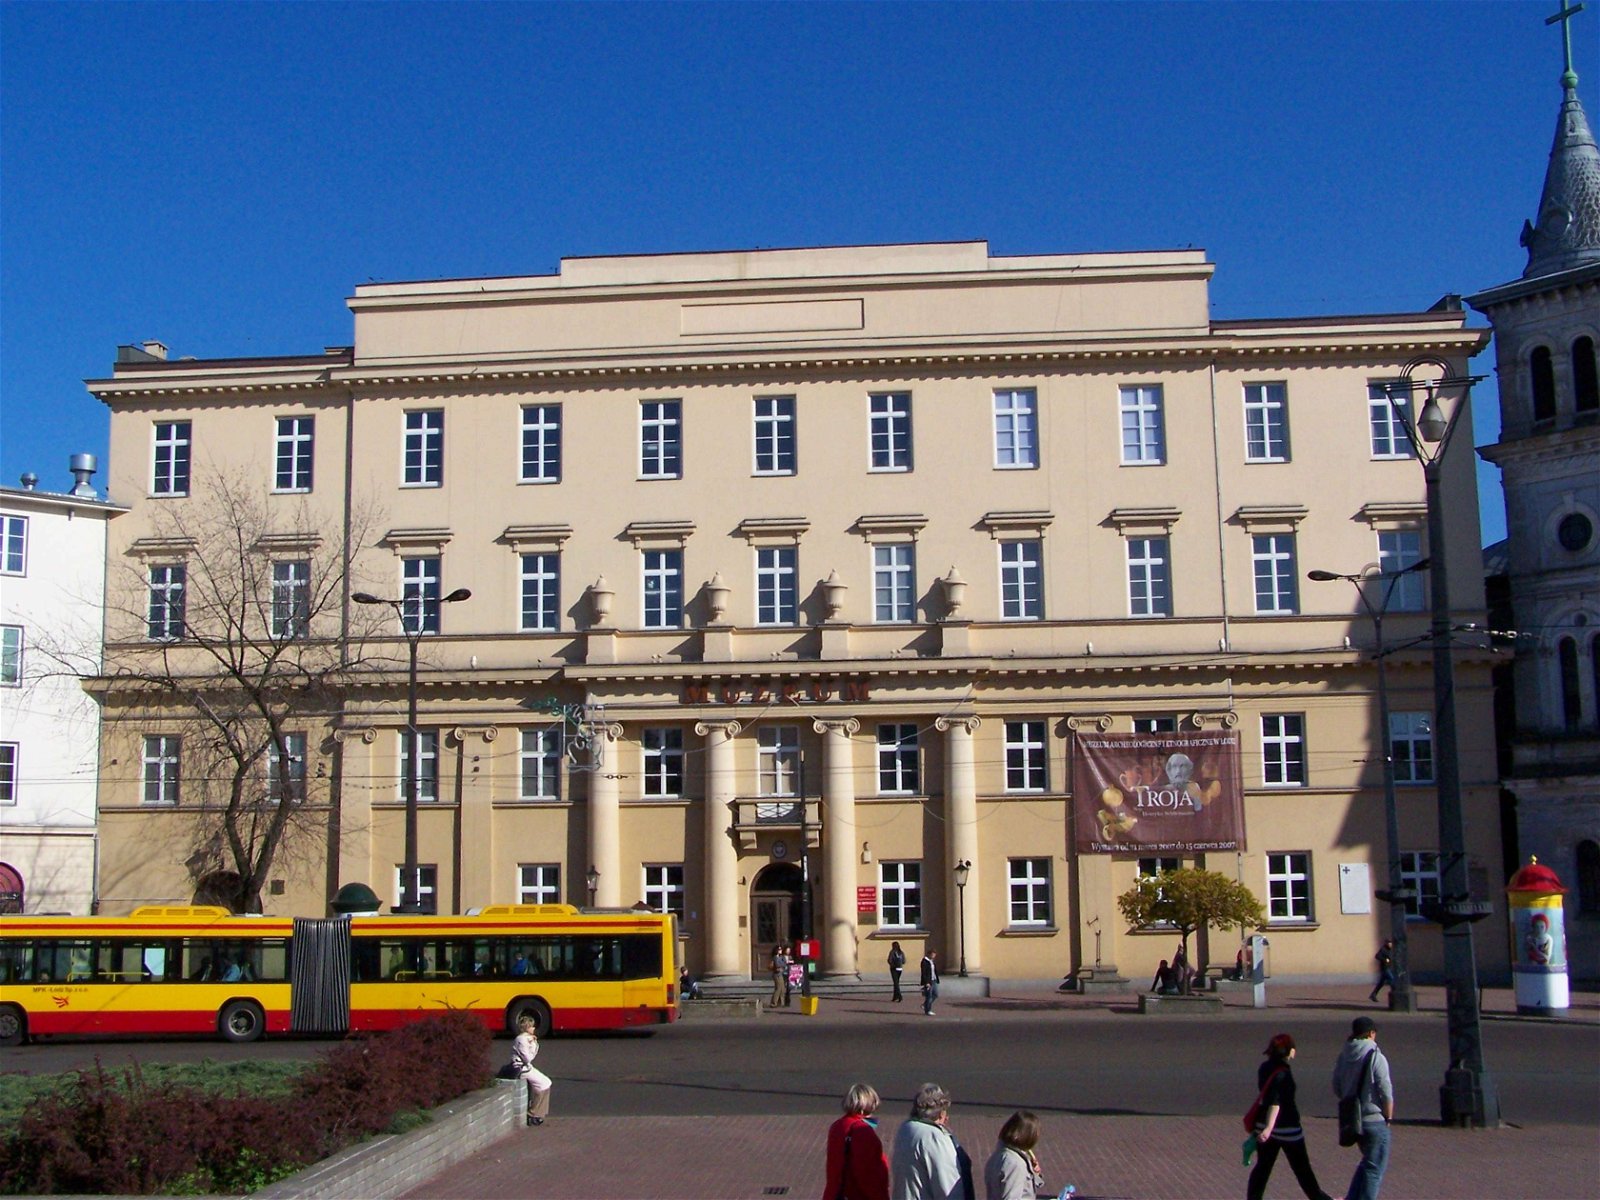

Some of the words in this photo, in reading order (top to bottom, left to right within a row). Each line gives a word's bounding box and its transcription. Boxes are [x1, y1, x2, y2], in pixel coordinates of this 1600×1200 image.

[684, 682, 871, 704] MUZEUM
[1130, 785, 1193, 809] TROJA
[1176, 841, 1185, 849] do
[1219, 841, 1235, 849] 2007
